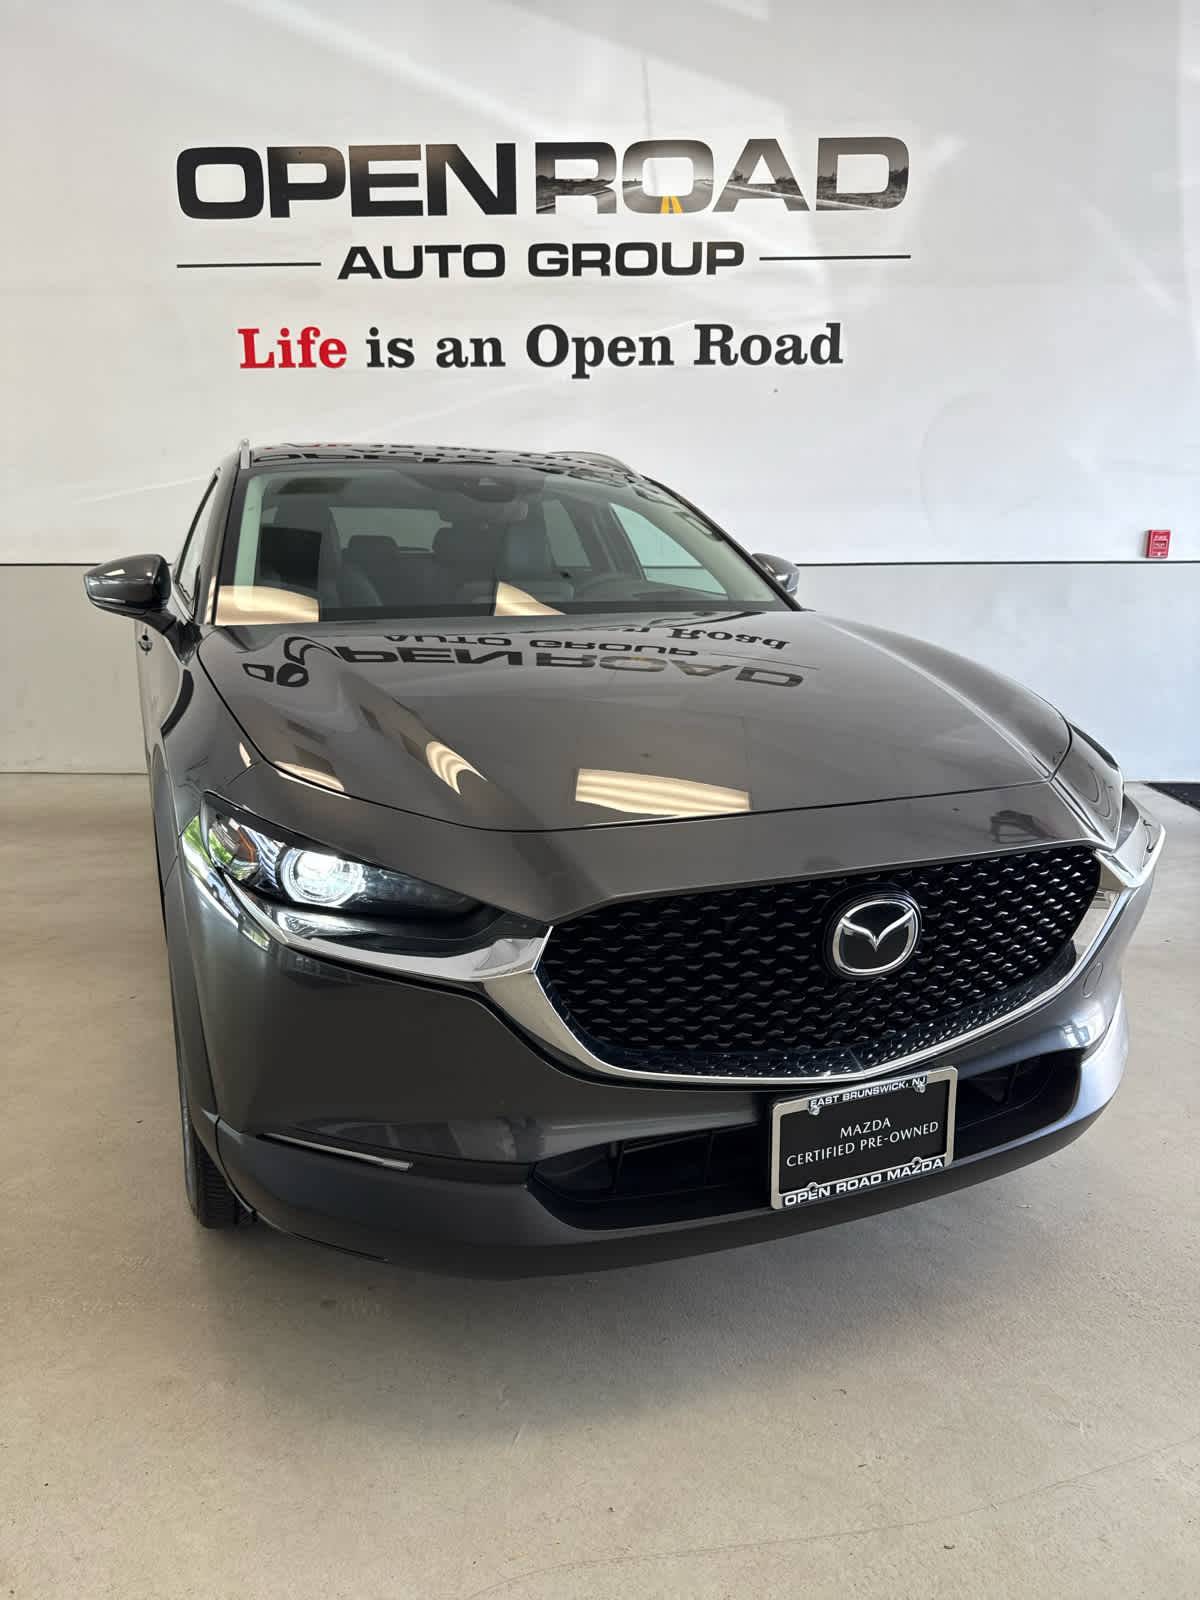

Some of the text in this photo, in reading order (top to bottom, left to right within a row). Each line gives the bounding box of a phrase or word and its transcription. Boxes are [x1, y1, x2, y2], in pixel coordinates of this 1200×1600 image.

[177, 137, 910, 219] OPEN ROAD
[338, 242, 745, 280] AUTO GROUP
[238, 323, 844, 380] Life is an Open Road
[810, 1095, 840, 1107] EAST
[912, 1077, 926, 1088] NJ
[786, 1121, 939, 1167] CERTIFIED PRE-OWNED
[839, 1117, 891, 1139] MAZDA
[784, 1158, 943, 1206] OPEN ROAD MAZDA
